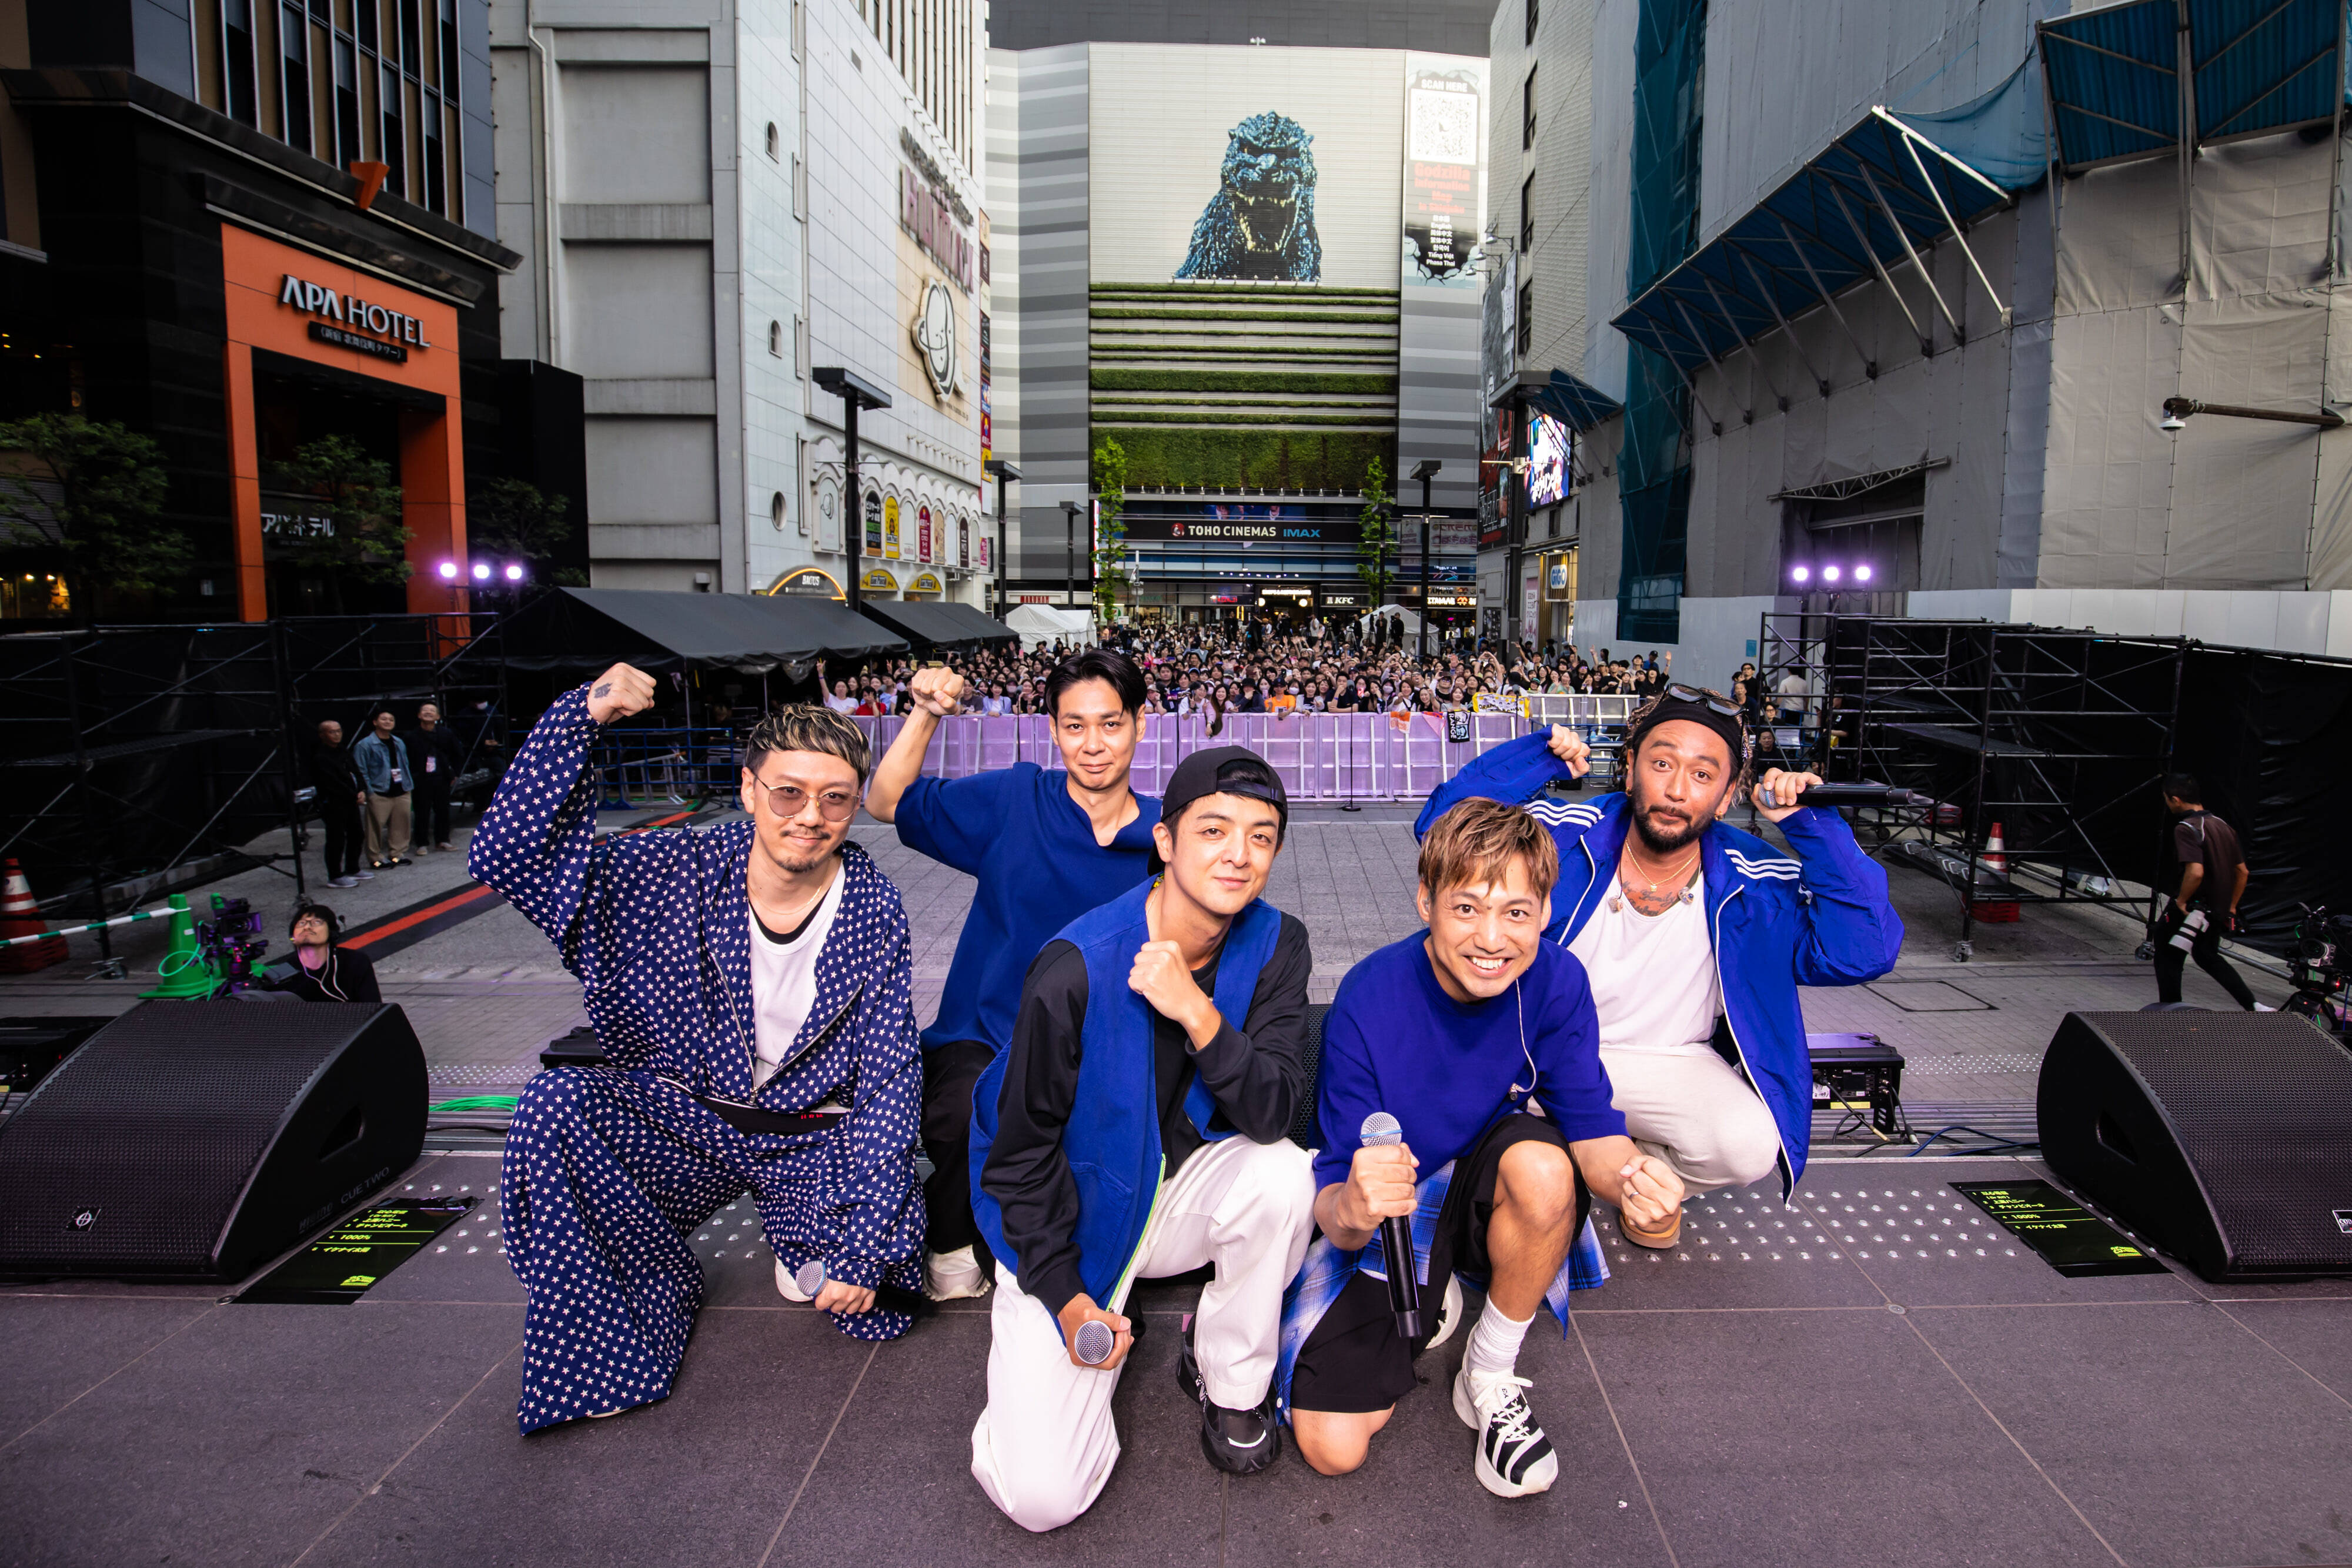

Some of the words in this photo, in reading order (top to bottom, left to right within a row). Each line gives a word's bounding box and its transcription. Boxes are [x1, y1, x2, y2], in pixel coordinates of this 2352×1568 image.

[1421, 79, 1444, 89] SCAN
[1446, 81, 1468, 92] HERE
[1414, 162, 1471, 181] Godzilla
[1414, 178, 1470, 192] Information
[1432, 190, 1453, 203] Map
[282, 274, 343, 321] APA
[345, 295, 431, 348] HOTEL
[1188, 525, 1221, 536] TOHO
[1223, 526, 1277, 537] CINEMAS
[1283, 529, 1321, 537] IMAX
[801, 574, 820, 586] BAGUS
[341, 1183, 363, 1204] CUE
[365, 1166, 390, 1188] TWO
